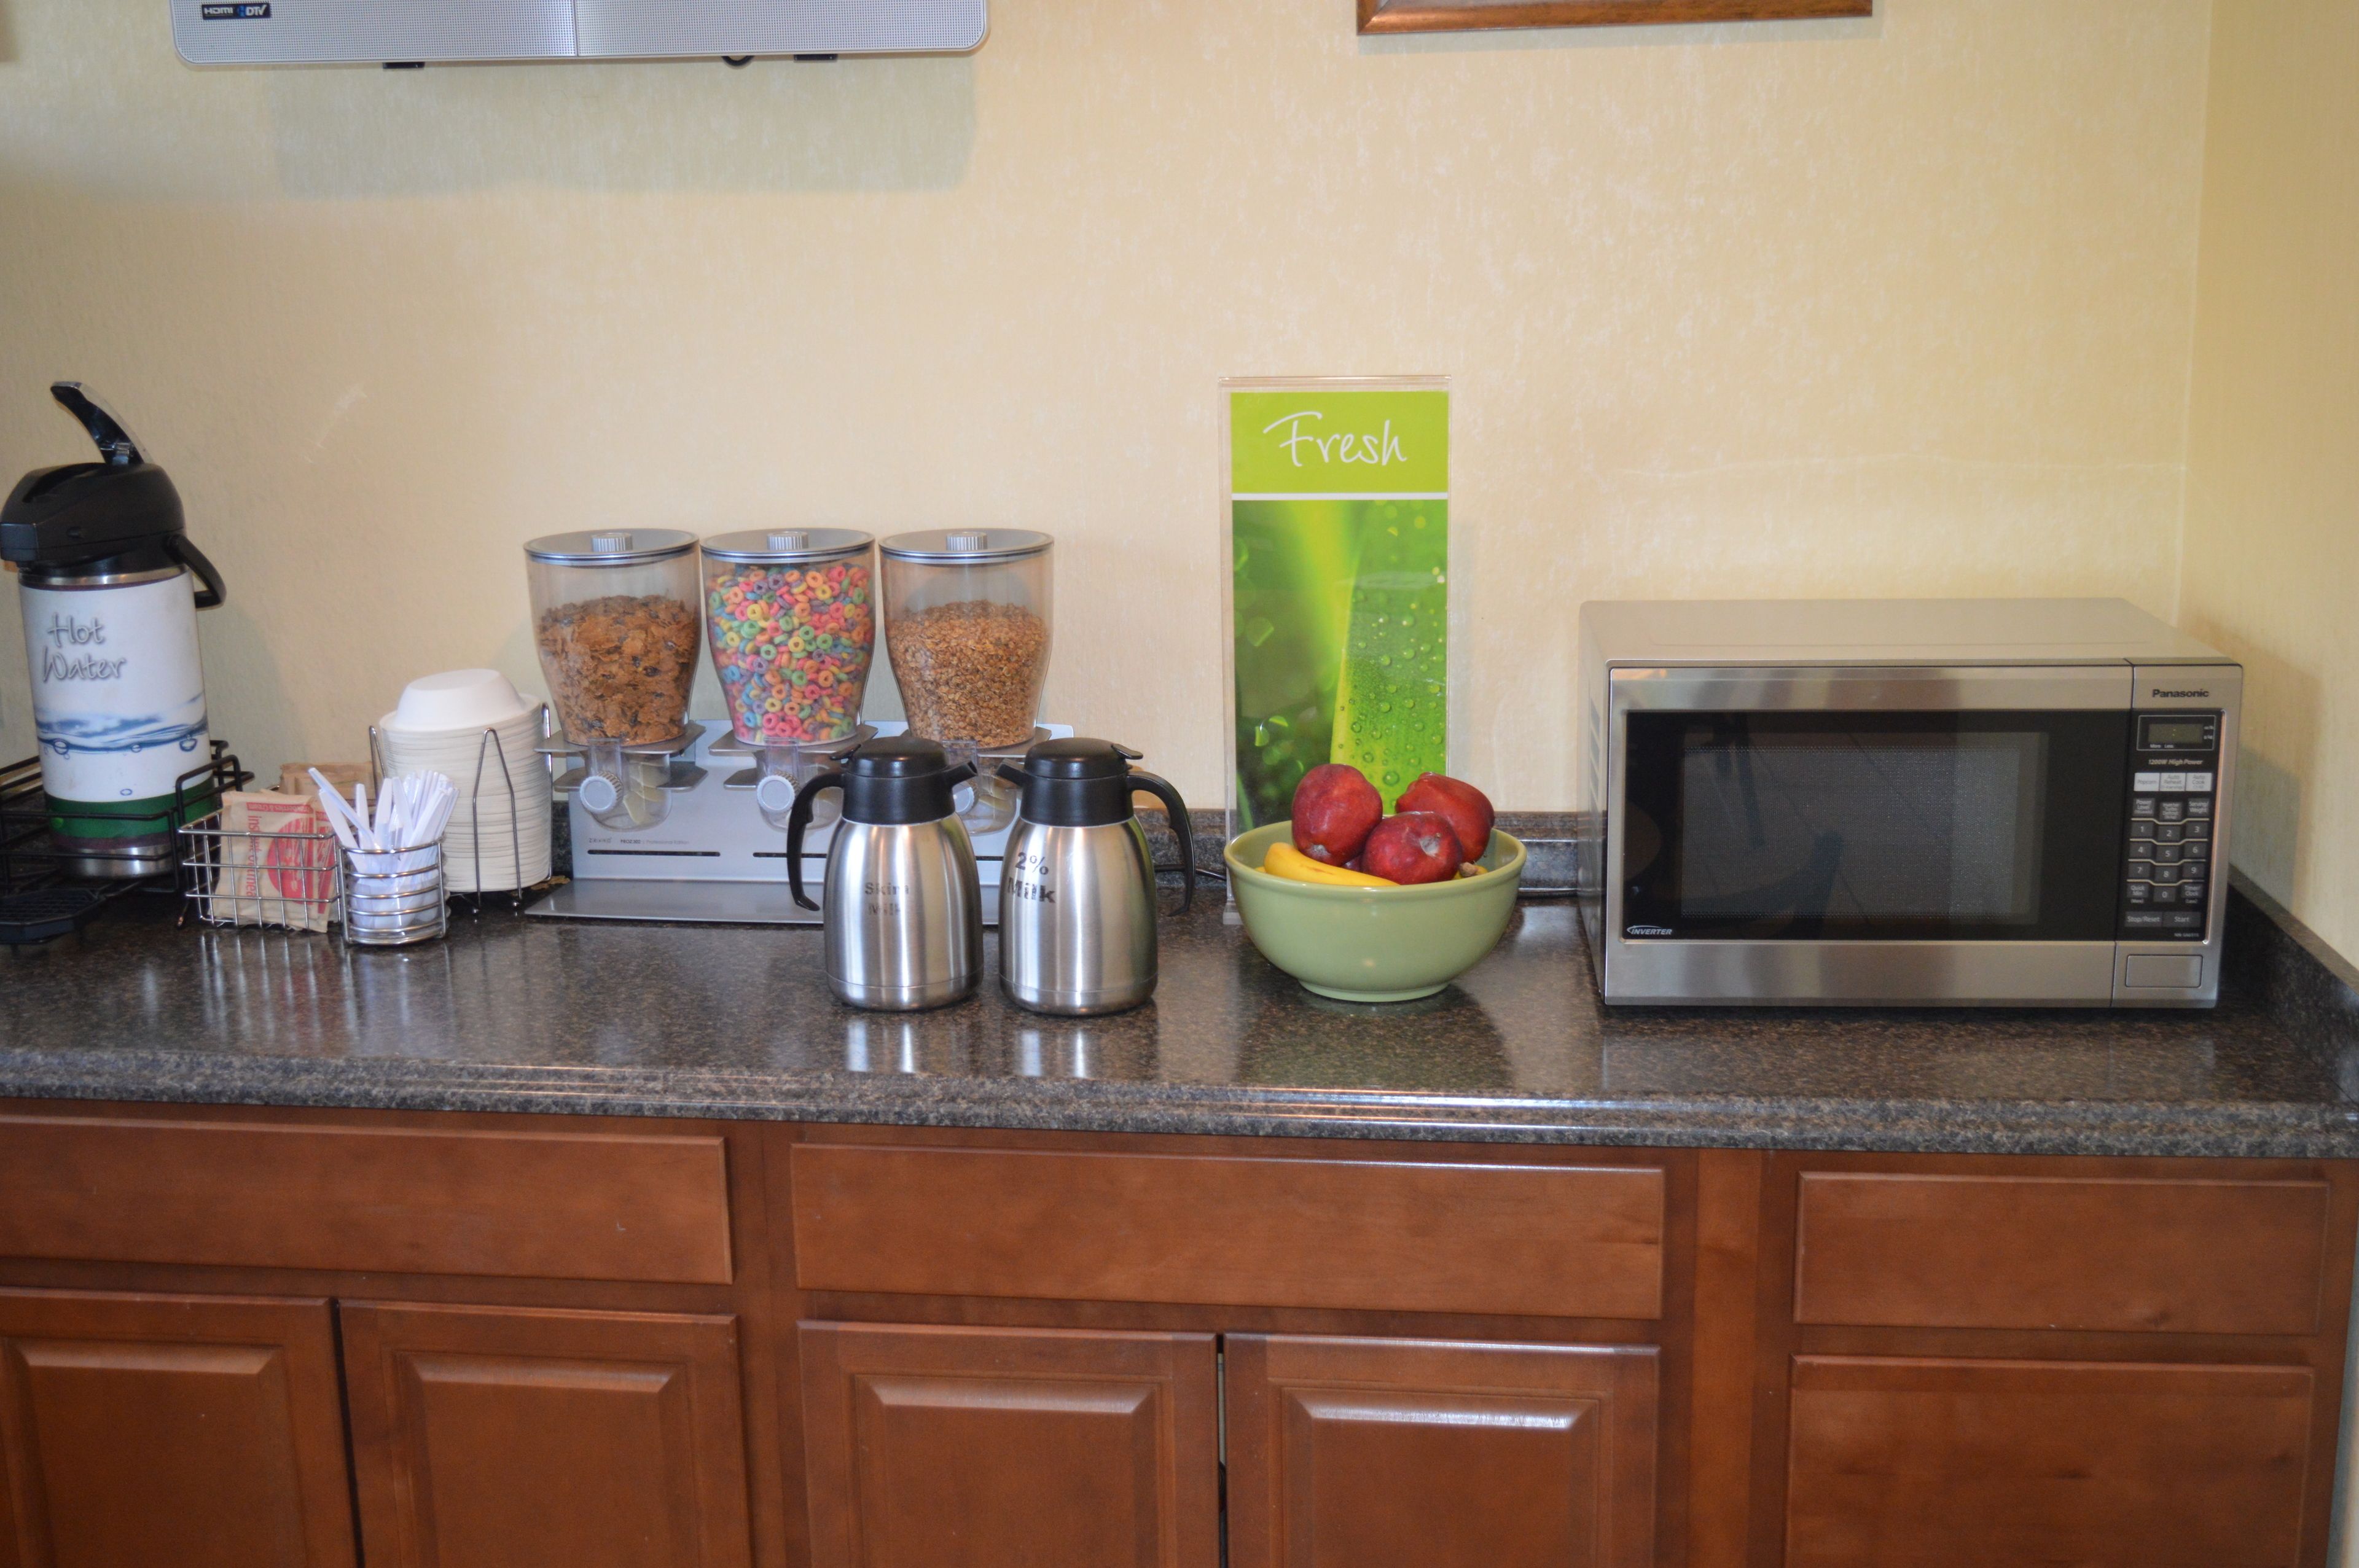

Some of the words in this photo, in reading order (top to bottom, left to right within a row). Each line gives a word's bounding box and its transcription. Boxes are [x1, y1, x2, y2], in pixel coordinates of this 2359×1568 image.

[1262, 411, 1407, 467] Fresh
[47, 612, 106, 647] Hot
[43, 646, 127, 682] Water
[2152, 688, 2210, 698] Panasonic
[1015, 852, 1049, 875] 2%
[1007, 876, 1056, 903] Milk
